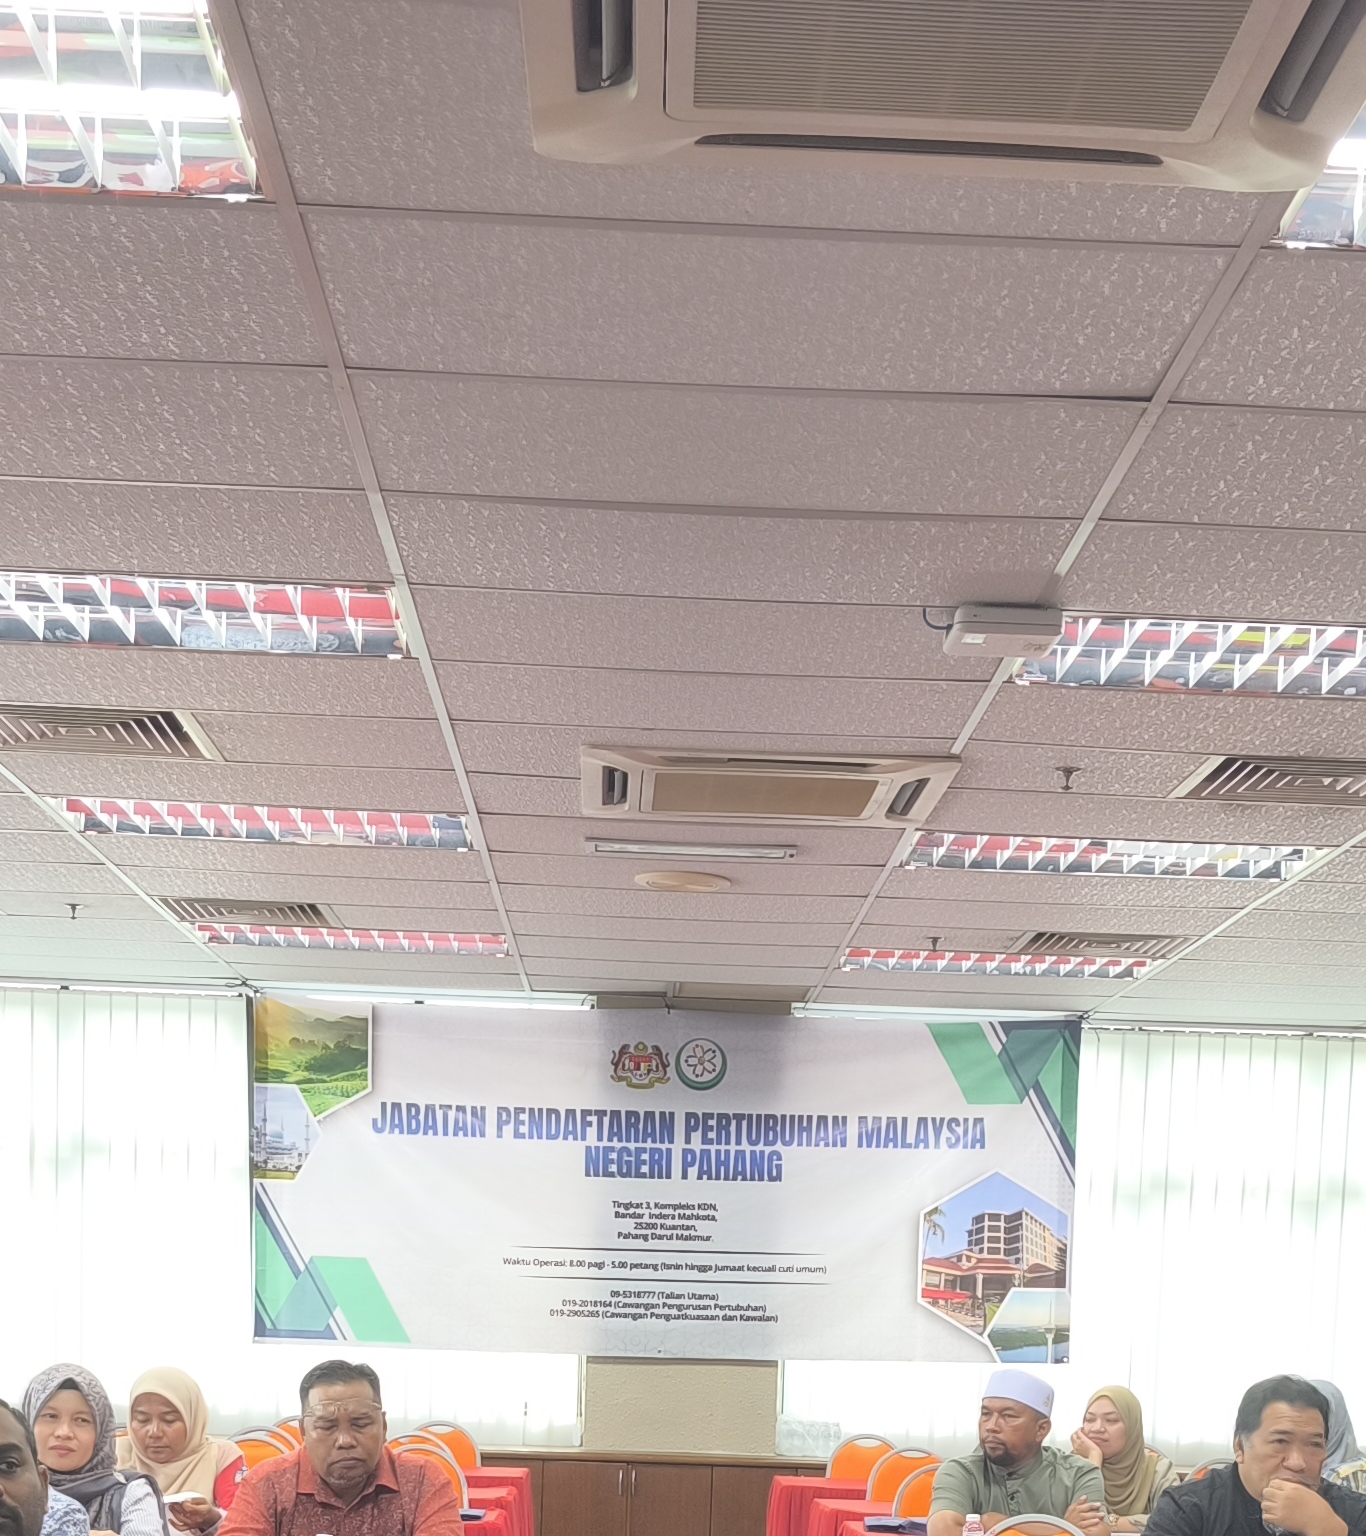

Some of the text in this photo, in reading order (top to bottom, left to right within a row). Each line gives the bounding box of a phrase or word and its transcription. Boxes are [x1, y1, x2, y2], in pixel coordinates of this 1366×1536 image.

[372, 1101, 986, 1150] JABATAN PENDAFTARAN PERTUBUHAN MALAYSIA
[584, 1145, 783, 1182] NEGERI PAHANG
[612, 1200, 719, 1212] Tingkat 3, Kompleks KDN,
[614, 1210, 718, 1222] Bandar Indera Mahkota,
[633, 1222, 698, 1232] 25200 Kuantan,
[617, 1231, 714, 1242] Pahang Darul Makmur.
[502, 1257, 531, 1266] Waktu
[569, 1259, 586, 1268] 8.00
[587, 1260, 605, 1271] pagi
[611, 1260, 629, 1269] 5.00
[629, 1261, 659, 1272] petang
[660, 1262, 683, 1271] (Isnin
[684, 1263, 713, 1273] hingga
[713, 1264, 745, 1273] Jumaat
[746, 1264, 777, 1273] kecuali
[795, 1266, 827, 1275] umum)
[657, 1291, 686, 1301] (Talian
[687, 1292, 719, 1302] Utama)
[613, 1300, 661, 1311] (Cawangan
[662, 1302, 712, 1312] Pengurusan
[713, 1303, 767, 1313] Pertubuhan)
[601, 1310, 649, 1321] (Cawangan
[650, 1311, 720, 1322] Penguatkuasaan
[721, 1313, 738, 1321] dan
[739, 1313, 778, 1323] Kawalan)
